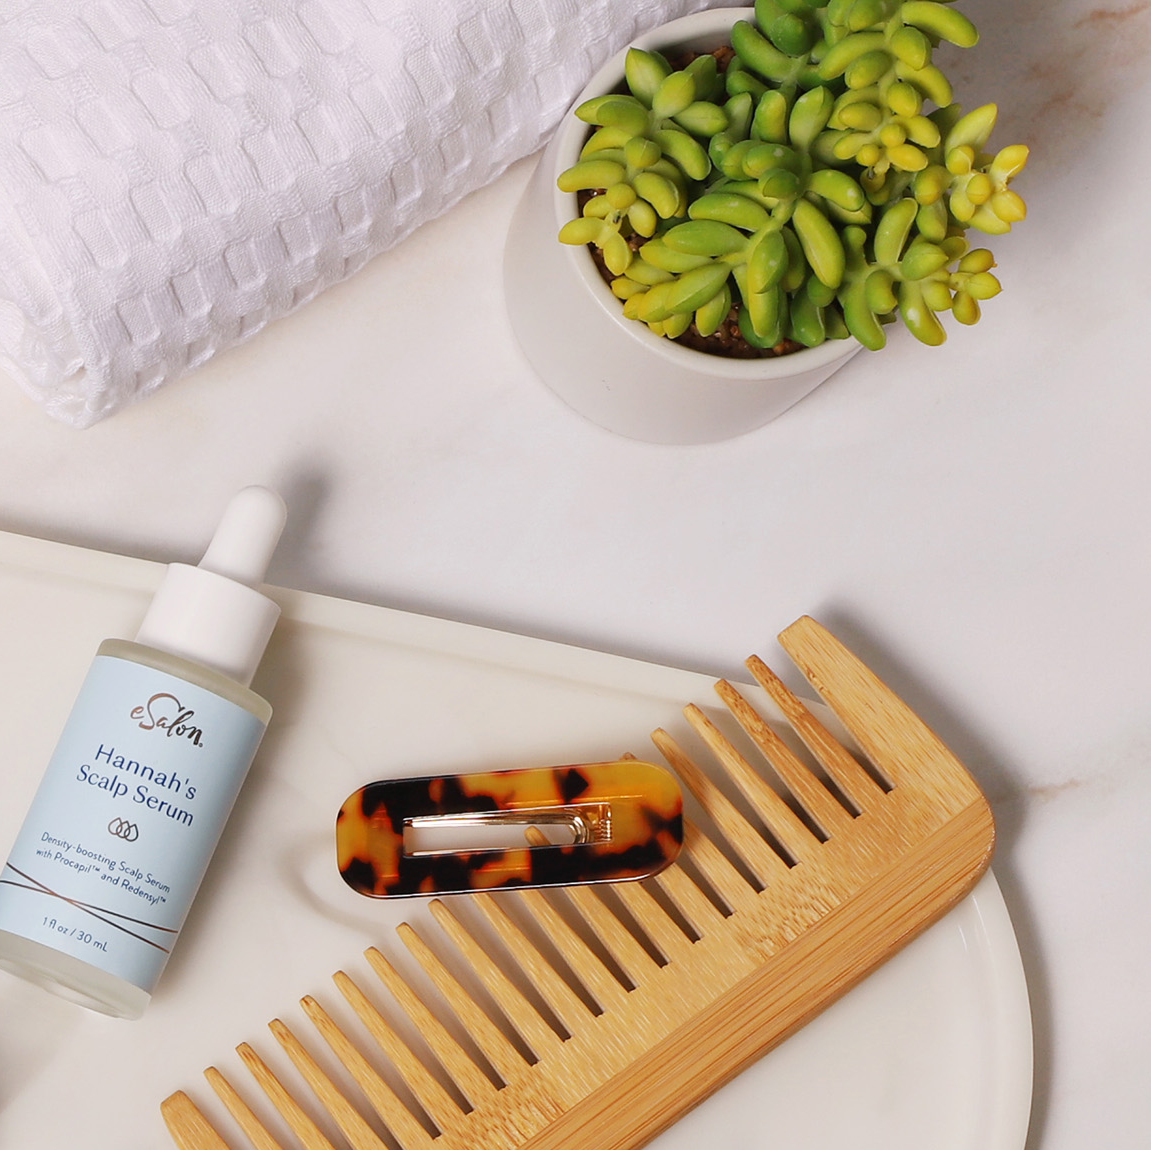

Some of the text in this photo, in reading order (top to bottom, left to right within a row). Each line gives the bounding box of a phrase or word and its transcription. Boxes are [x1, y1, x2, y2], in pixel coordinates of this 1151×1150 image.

[76, 764, 194, 827] Scalp Serum
[94, 743, 198, 800] Hannah's
[36, 848, 53, 860] with
[101, 873, 120, 886] and
[41, 831, 171, 894] Density-boosting Scalp Serum
[42, 916, 48, 926] 1
[57, 924, 69, 935] oz
[76, 930, 93, 944] 30
[93, 941, 108, 953] mL
